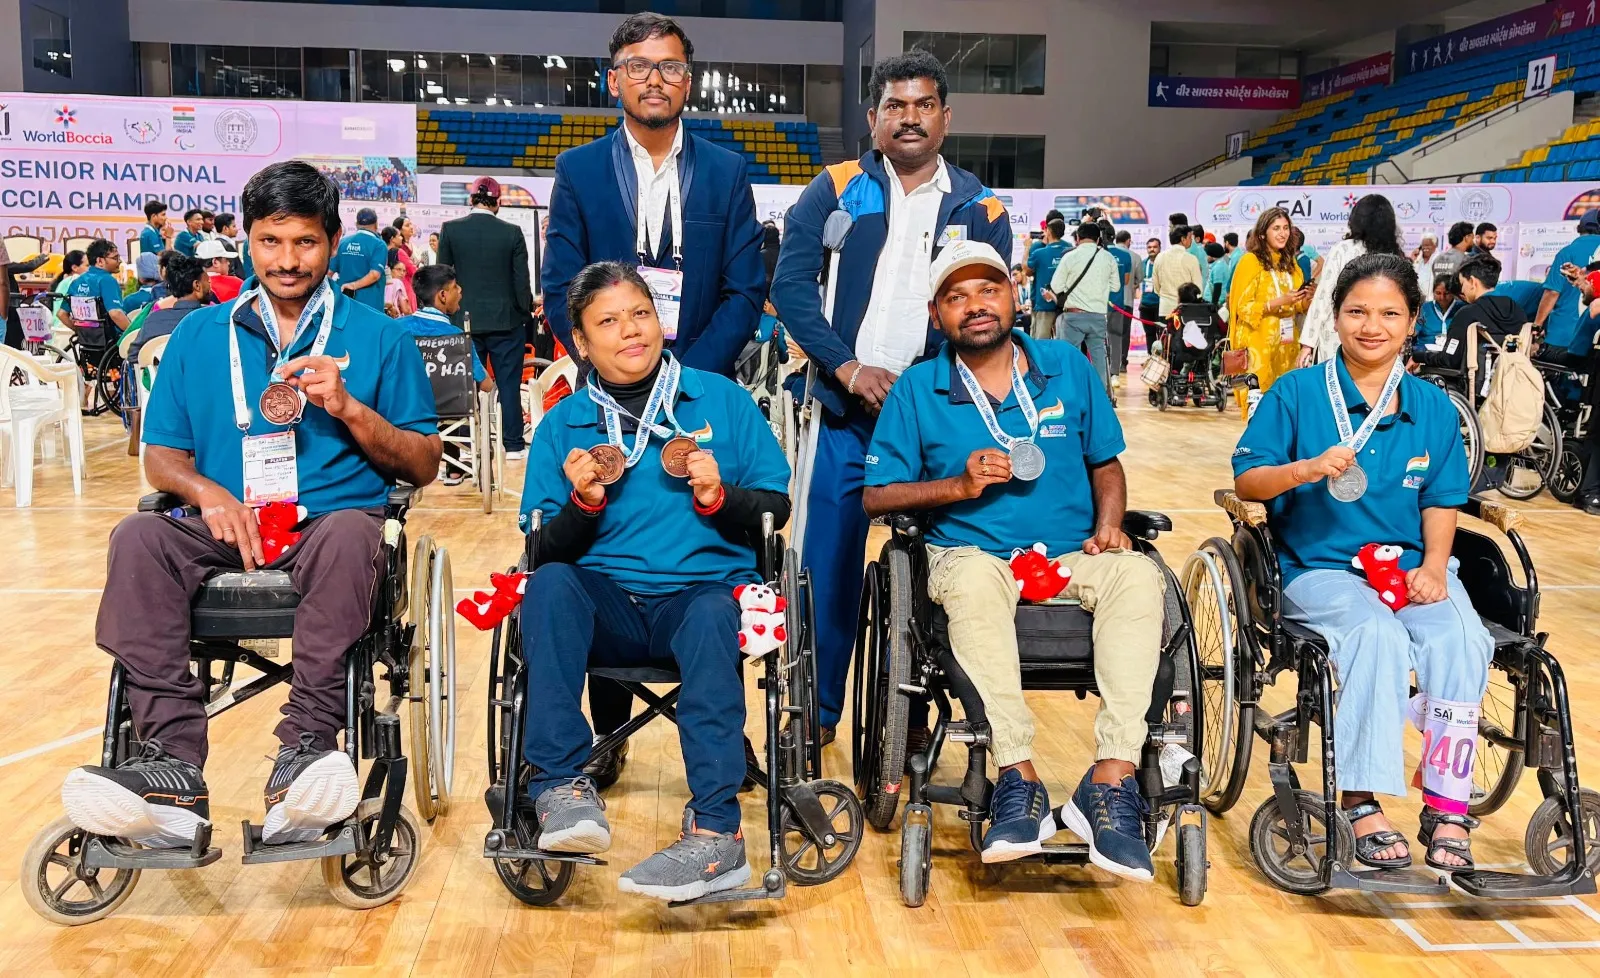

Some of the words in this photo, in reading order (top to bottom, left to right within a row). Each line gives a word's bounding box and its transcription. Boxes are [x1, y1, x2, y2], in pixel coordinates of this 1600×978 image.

[1531, 63, 1547, 91] 11
[1175, 84, 1190, 97] વીર
[1191, 88, 1224, 98] સાવરકર
[22, 130, 113, 144] WorldBoccia
[1, 160, 94, 180] SENIOR
[102, 163, 226, 184] NATIONAL
[2, 190, 62, 209] CCIA
[1010, 214, 1028, 224] SAI
[1434, 708, 1452, 720] SAI
